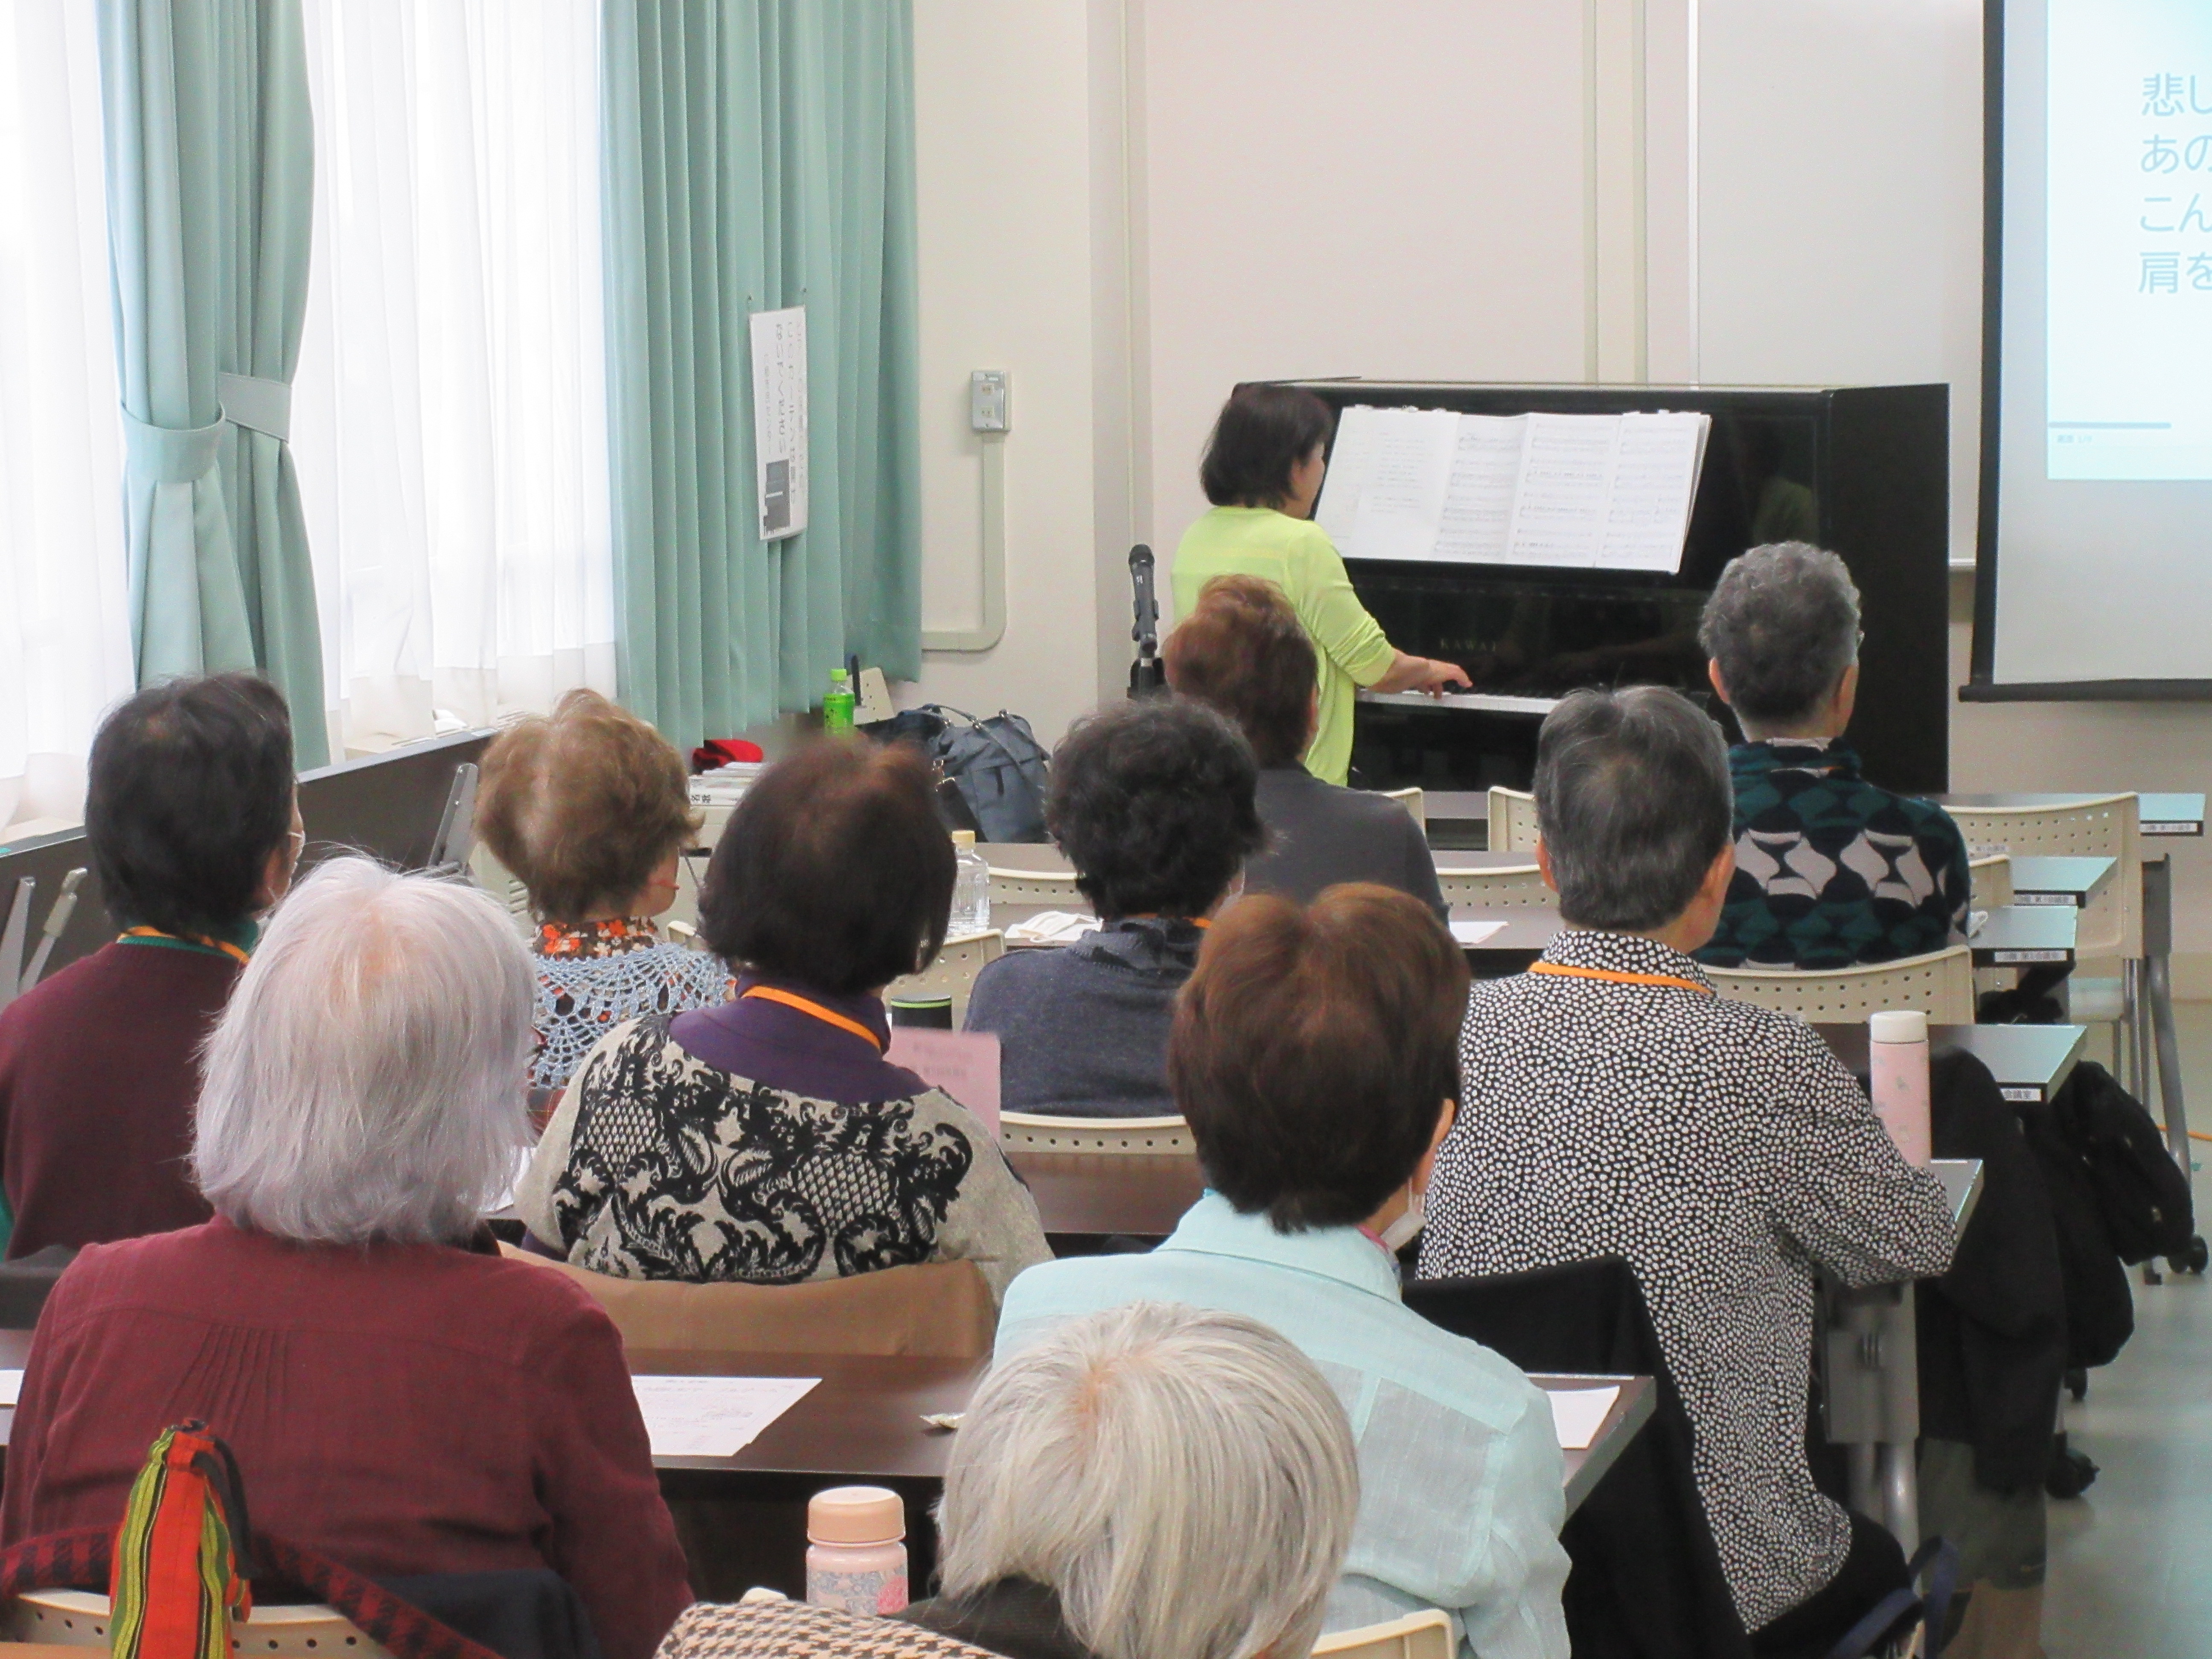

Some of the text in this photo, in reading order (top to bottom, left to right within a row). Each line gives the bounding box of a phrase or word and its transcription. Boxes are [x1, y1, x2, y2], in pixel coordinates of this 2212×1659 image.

[2142, 72, 2212, 117] 悲し
[2141, 134, 2212, 174] あの
[2140, 192, 2212, 233] こん
[2138, 251, 2212, 294] 肩を
[1440, 637, 1496, 652] KAWAI
